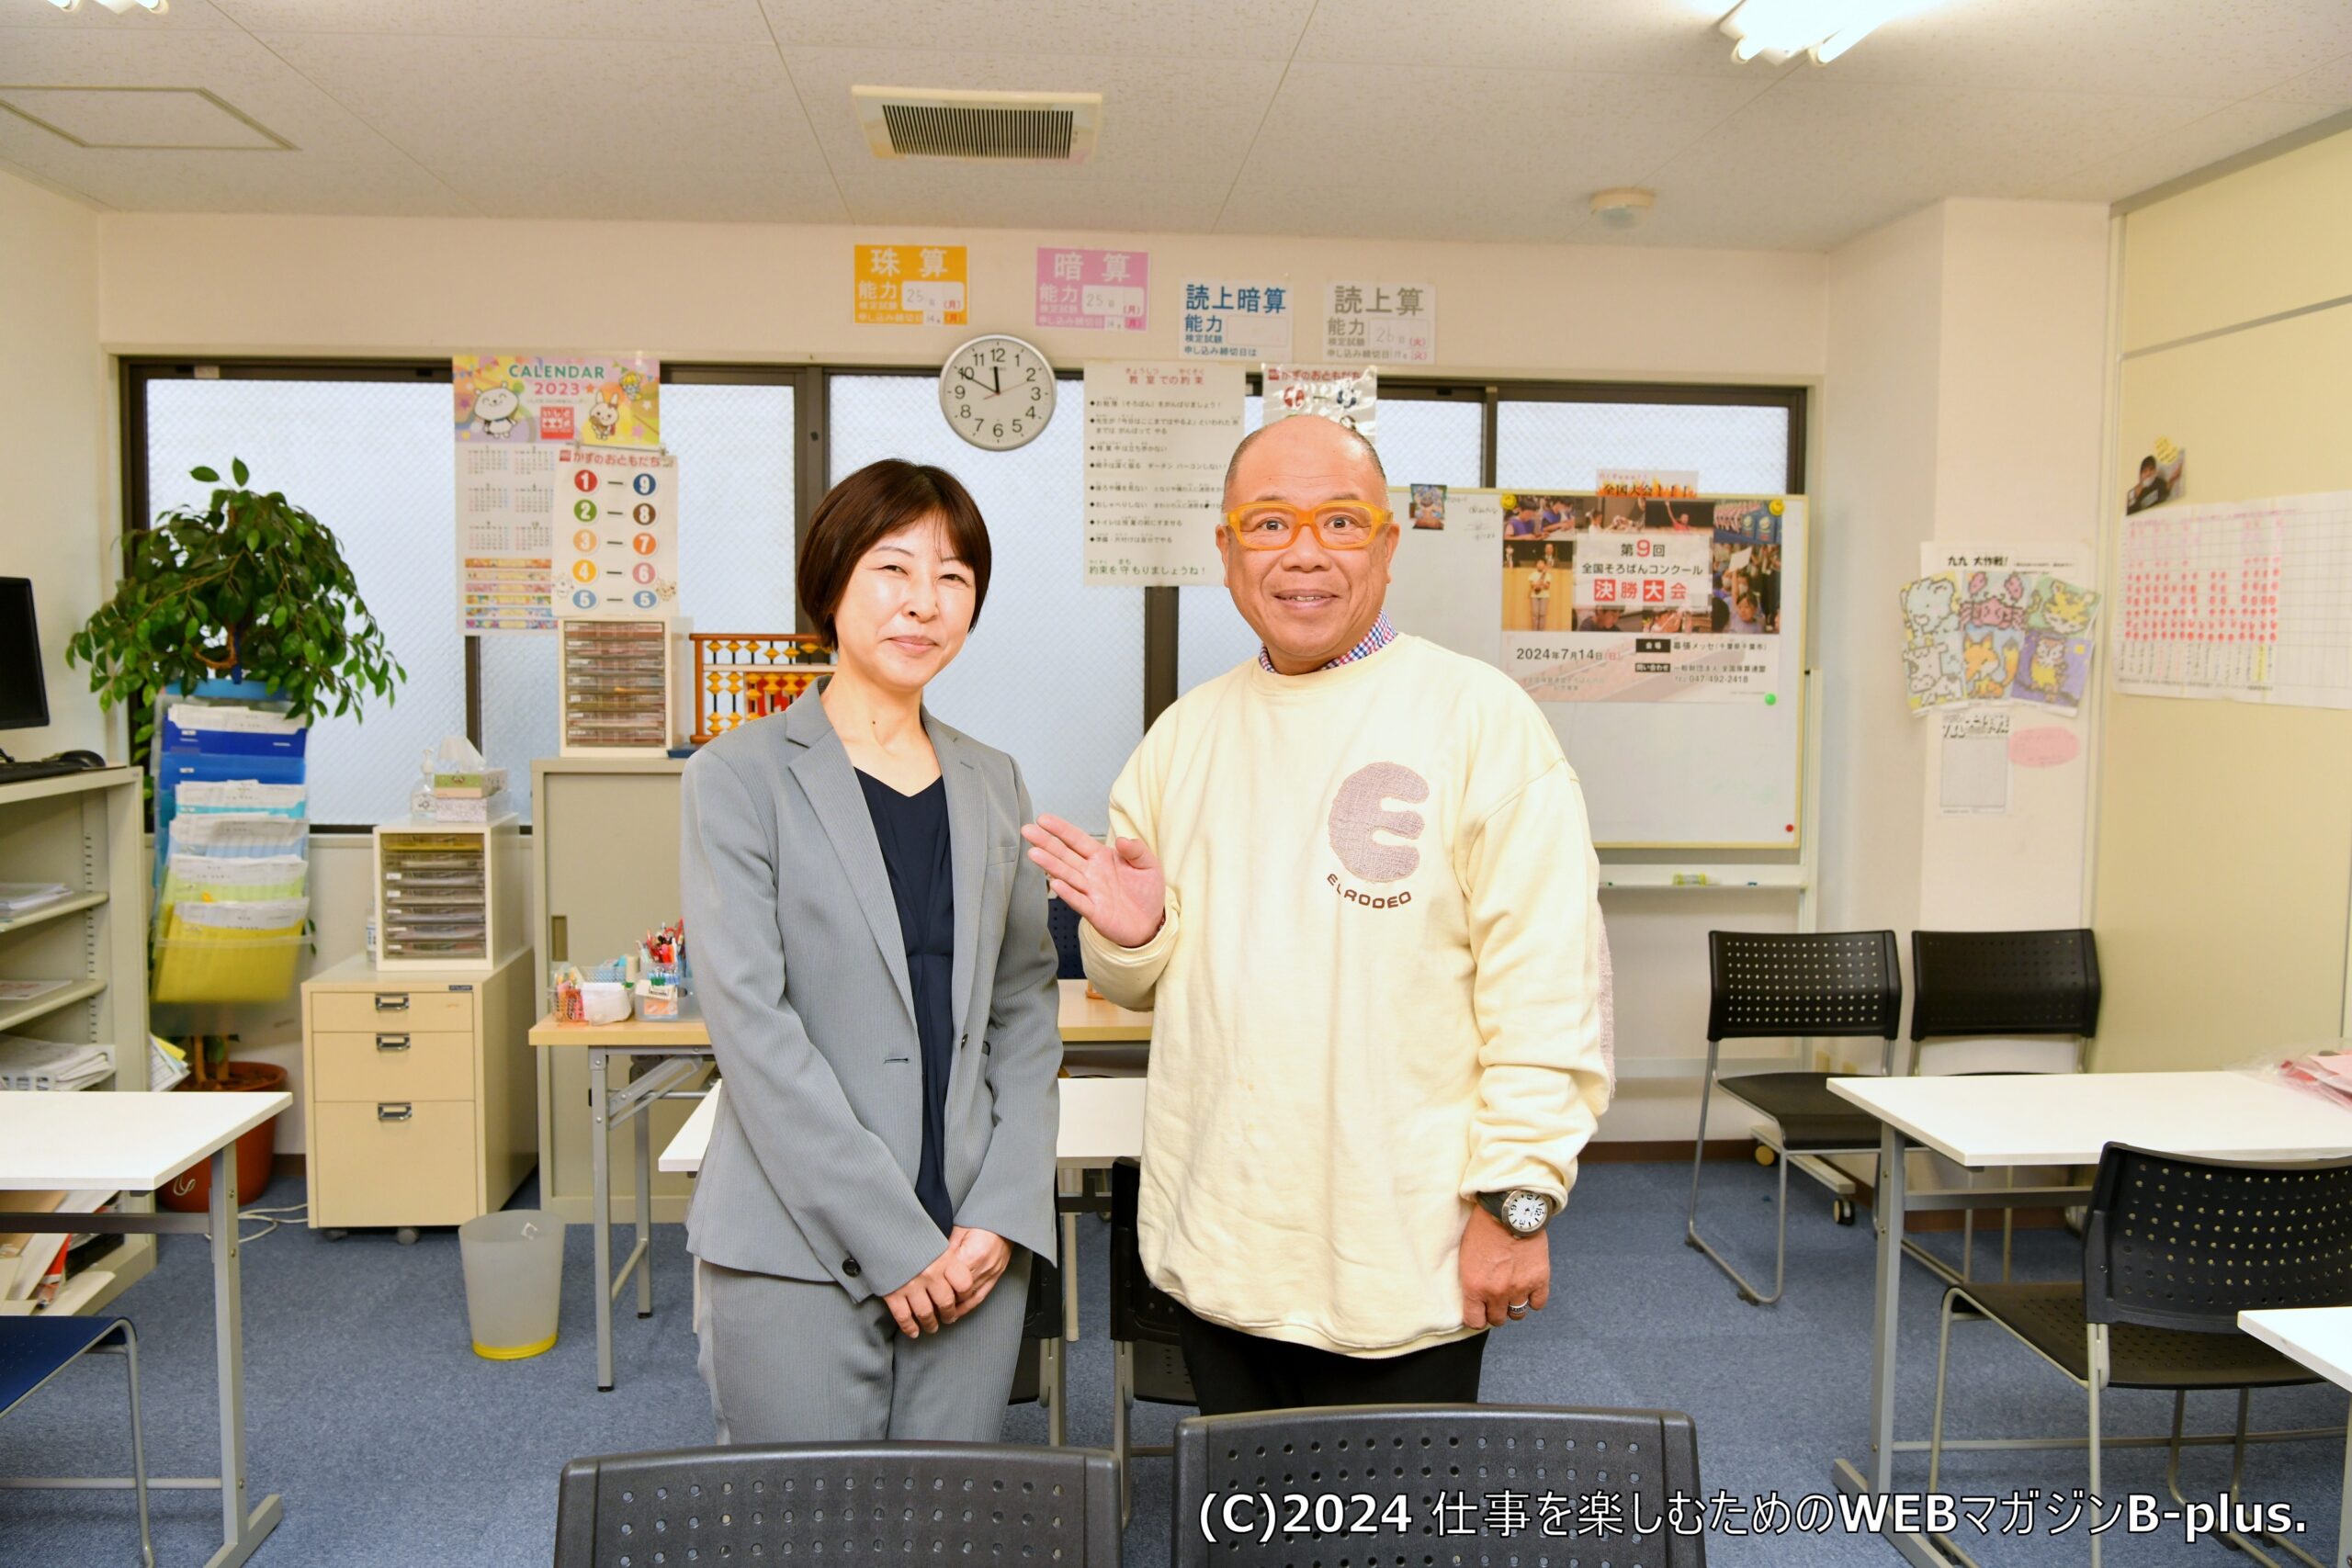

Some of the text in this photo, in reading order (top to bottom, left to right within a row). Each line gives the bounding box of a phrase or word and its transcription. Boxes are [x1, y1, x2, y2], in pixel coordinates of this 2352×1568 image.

[870, 248, 948, 277] 珠算
[1055, 253, 1132, 282] 暗算
[859, 280, 898, 299] 能力
[1040, 283, 1079, 303] 能力
[1186, 284, 1286, 313] 読上暗算
[1334, 286, 1424, 316] 読上算
[1185, 314, 1223, 333] 能力
[1328, 317, 1365, 336] 能力
[1185, 334, 1223, 344] 検定試験
[990, 348, 1005, 362] 12
[1184, 345, 1257, 356] 申し込み締切日は
[973, 354, 985, 367] 11
[1014, 354, 1020, 367] 1
[509, 365, 605, 378] CALENDAR
[958, 367, 974, 380] 10
[1026, 367, 1036, 382] 2
[534, 382, 580, 395] 2023
[955, 385, 966, 400] 9
[1031, 387, 1041, 400] 3
[960, 404, 971, 419] 8
[1025, 405, 1036, 419] 4
[975, 418, 985, 432] 7
[992, 423, 1003, 437] 6
[1012, 419, 1023, 433] 5
[573, 452, 660, 467] かずのおともだち
[581, 473, 650, 493] 1 9
[581, 502, 650, 523] 2 8
[580, 533, 650, 553] 3 7
[1621, 539, 1666, 558] 第9回
[1581, 563, 1703, 575] 全国そろばんコンクール
[1948, 557, 1968, 567] 九九
[579, 563, 650, 582] 4 6
[1594, 580, 1687, 602] 決勝大会
[580, 592, 650, 608] 5 5
[1328, 761, 1430, 883] E
